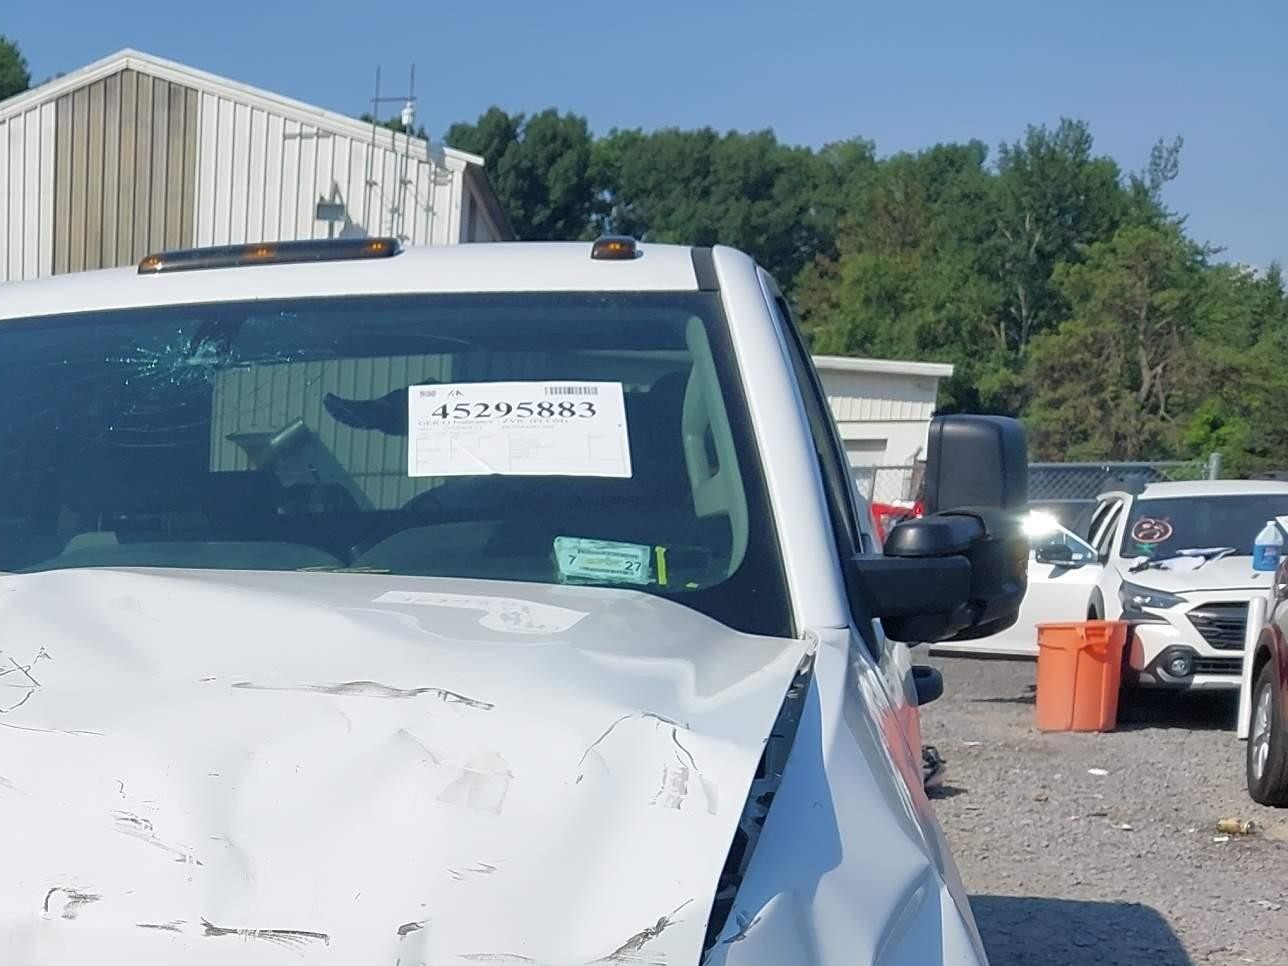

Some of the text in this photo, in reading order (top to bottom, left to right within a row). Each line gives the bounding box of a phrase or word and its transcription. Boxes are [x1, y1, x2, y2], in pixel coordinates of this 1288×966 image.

[431, 401, 597, 419] 45295883
[568, 554, 577, 565] 7
[625, 561, 642, 572] 27
